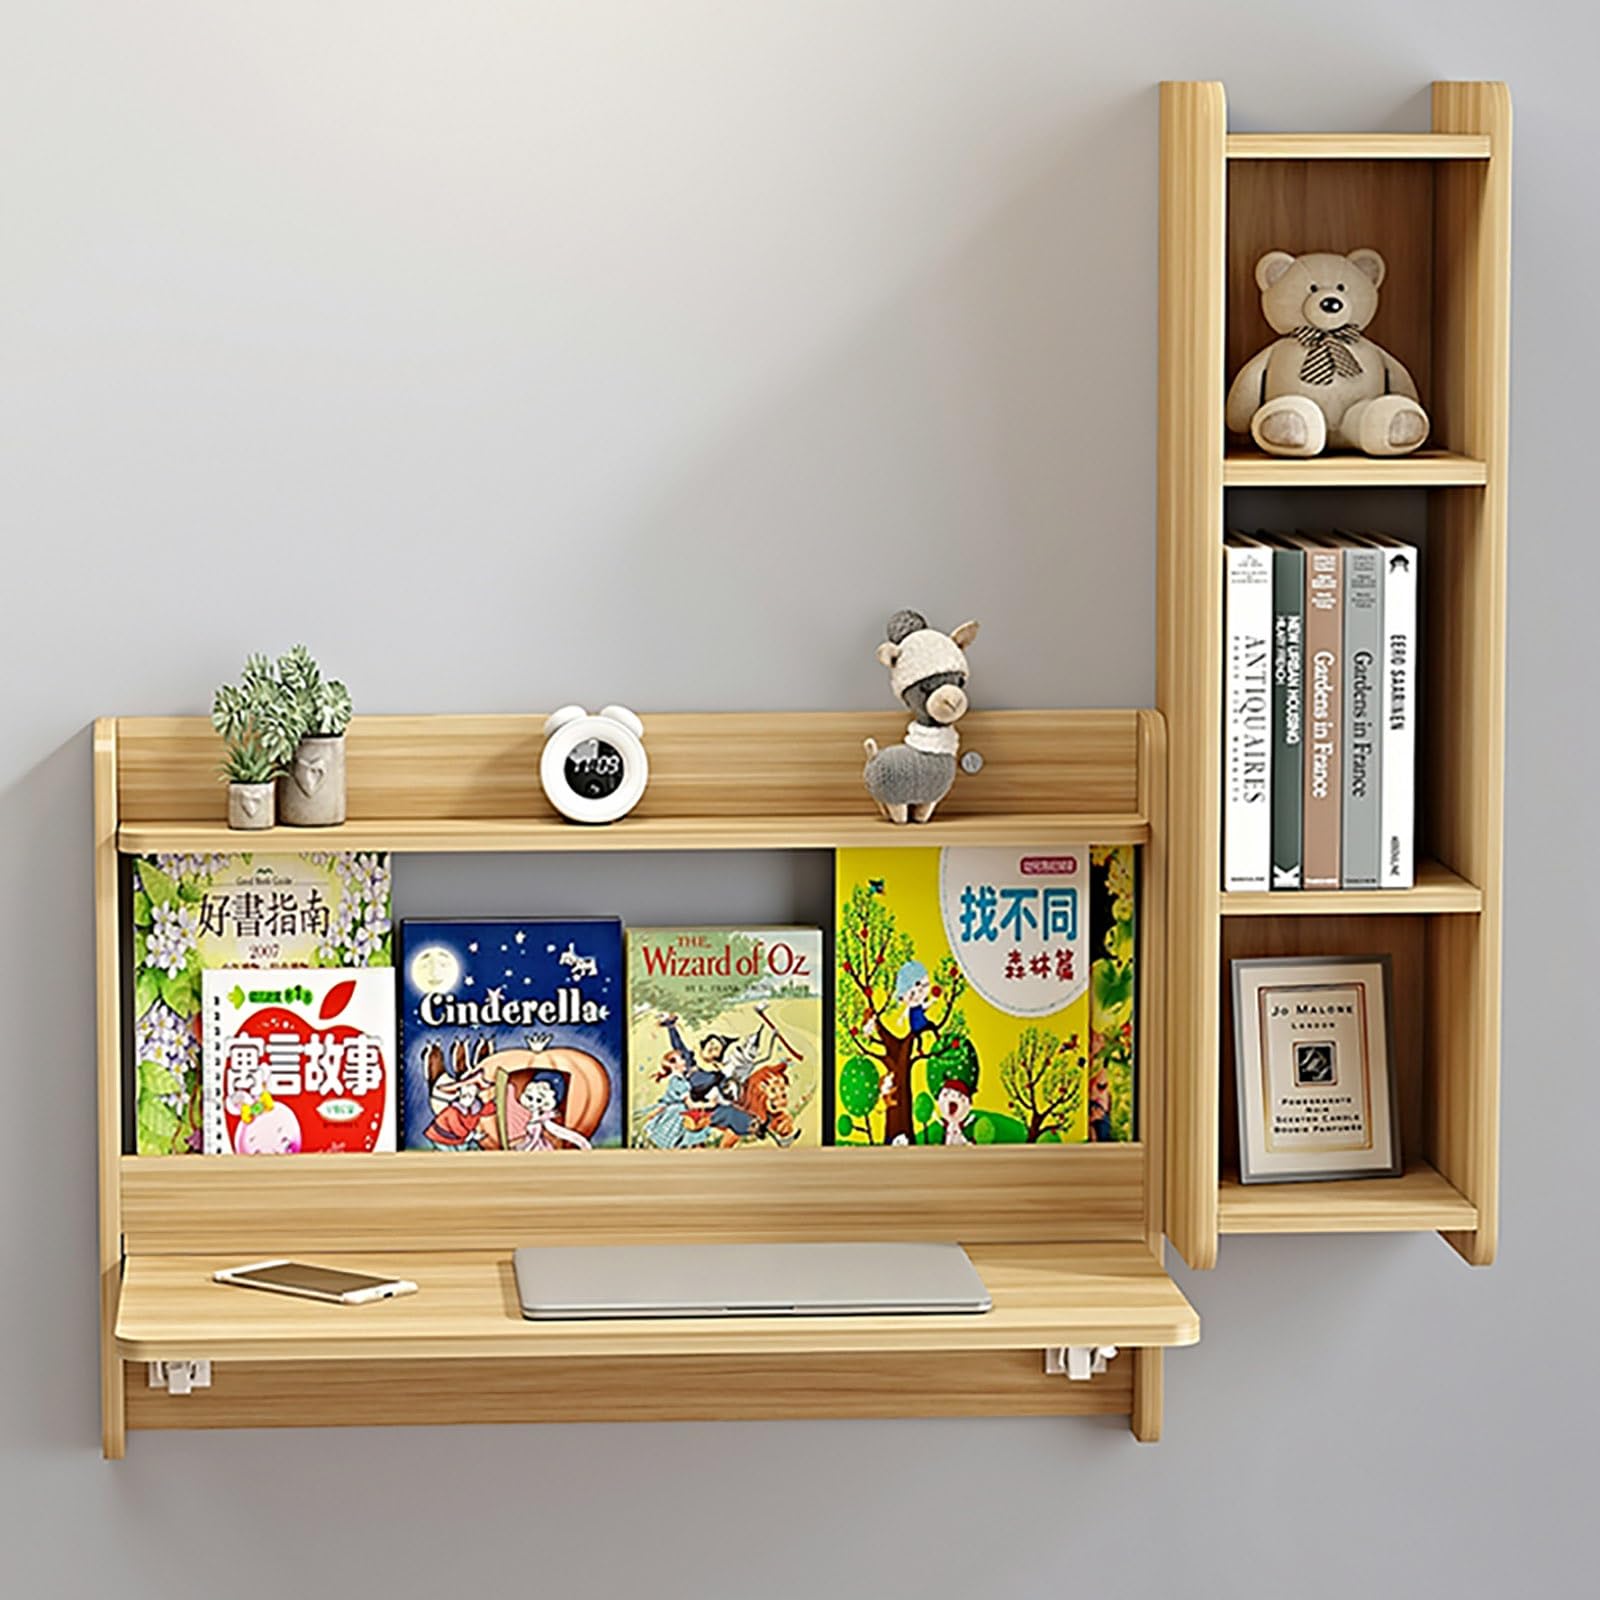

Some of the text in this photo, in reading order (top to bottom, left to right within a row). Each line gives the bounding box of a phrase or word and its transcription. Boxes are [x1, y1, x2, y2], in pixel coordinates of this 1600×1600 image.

[1286, 615, 1300, 745] NEW URBAN HOUSING
[1389, 634, 1407, 731] EERO SAARINEN
[1239, 635, 1267, 804] ANTIQUAIRES
[1312, 650, 1335, 799] Gardens in France
[1352, 650, 1374, 798] Gardens in France
[198, 888, 330, 938] 好書指南
[677, 936, 708, 947] THE
[959, 885, 1078, 942] 找不同
[249, 944, 280, 959] 2007
[642, 941, 811, 977] Wizard of Oz
[420, 988, 600, 1026] Cinderella
[224, 1031, 384, 1097] 寓言故事
